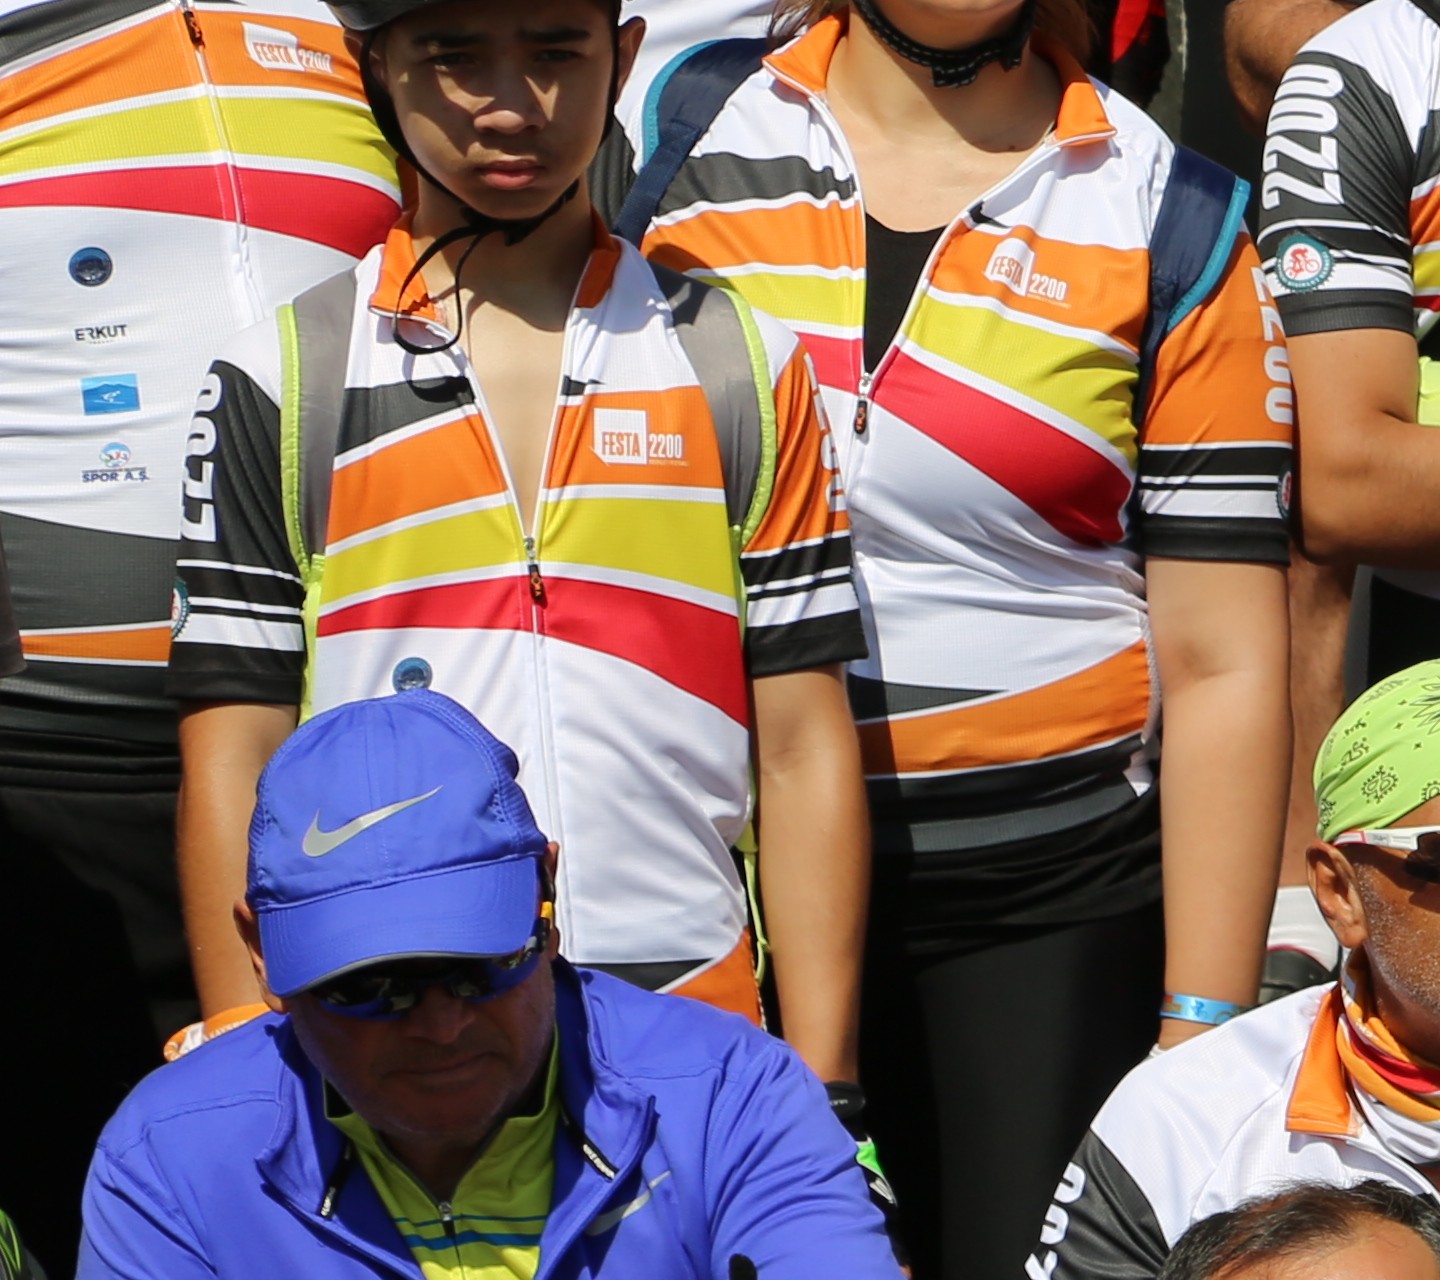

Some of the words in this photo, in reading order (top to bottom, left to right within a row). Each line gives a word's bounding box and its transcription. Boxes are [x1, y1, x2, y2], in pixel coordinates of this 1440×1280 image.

[251, 41, 297, 65] FESTA
[1261, 62, 1345, 211] 2200
[1028, 274, 1068, 303] 2200
[74, 324, 128, 343] ERKUT
[600, 431, 641, 460] FESTA
[647, 431, 685, 462] 2200
[81, 471, 120, 484] SPOR
